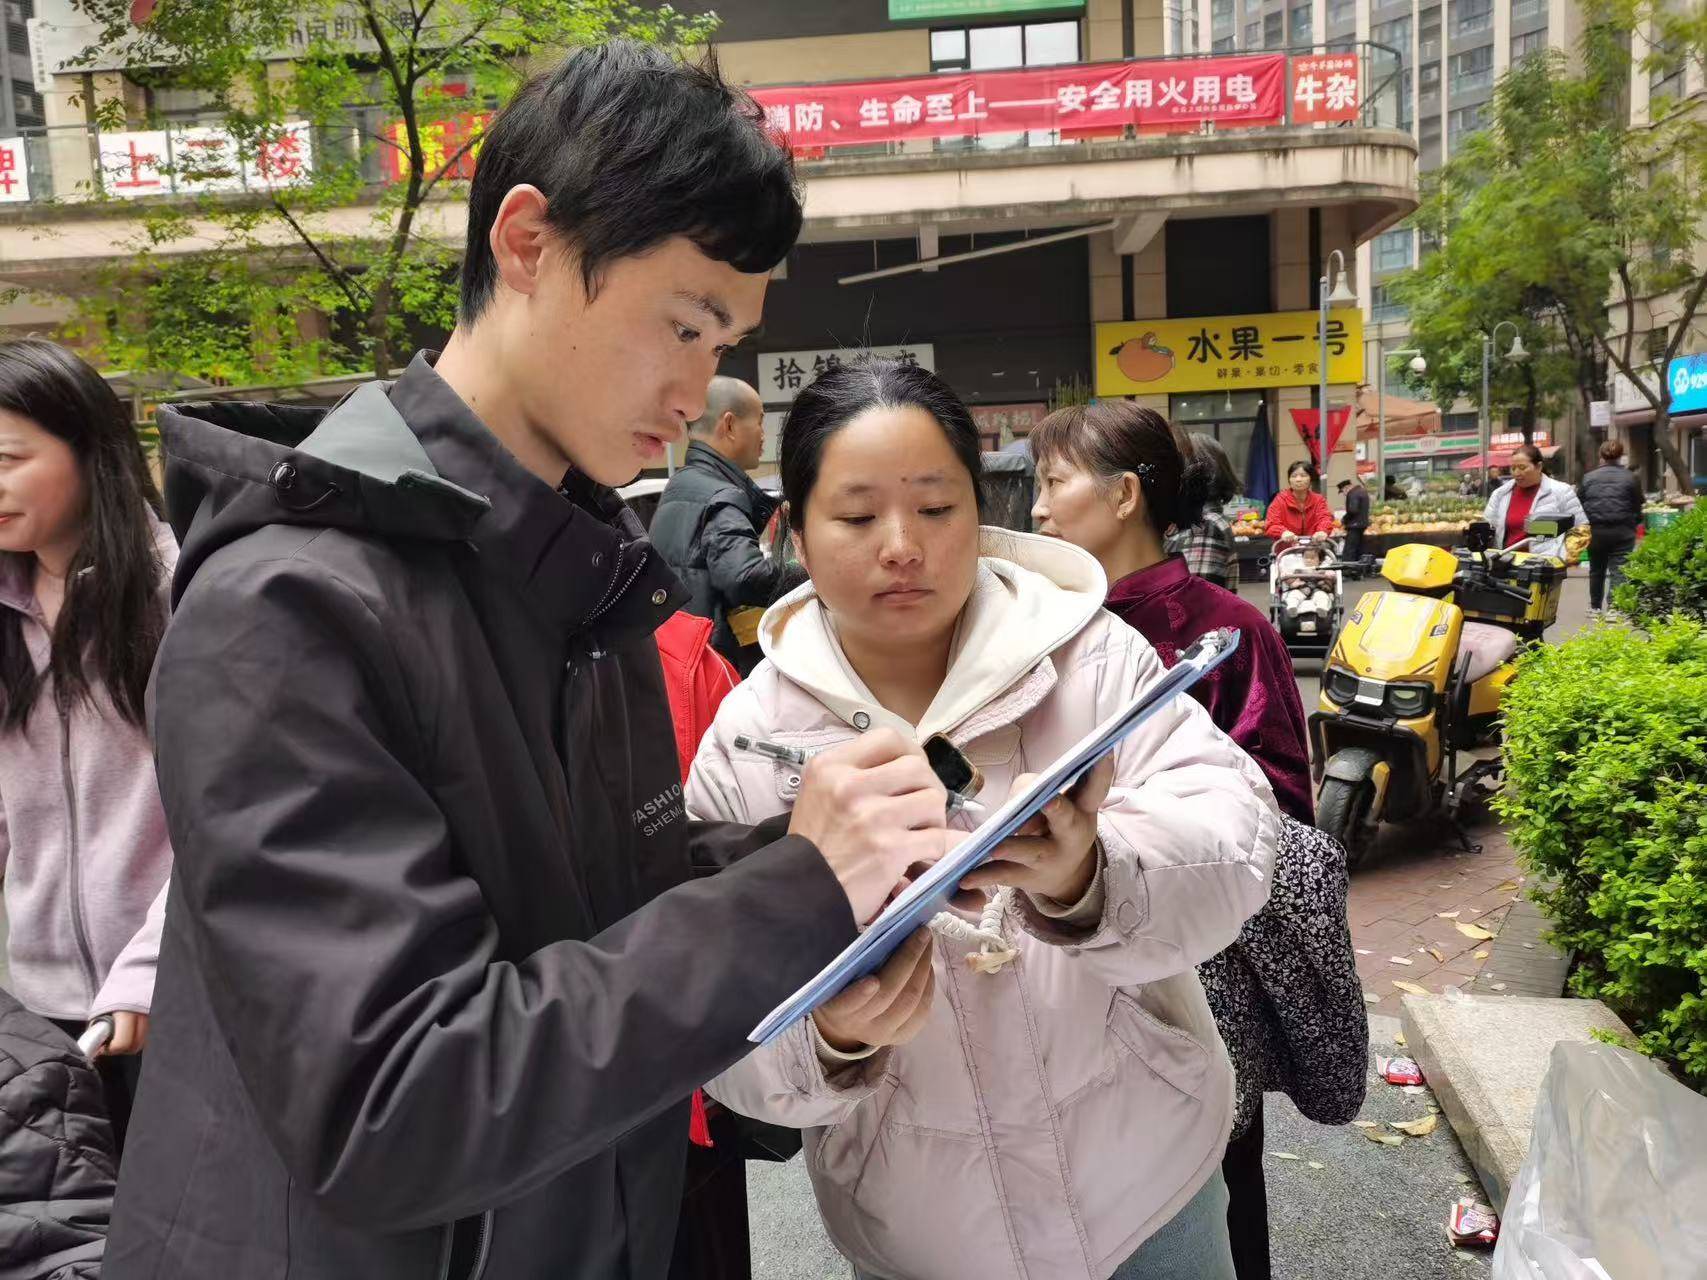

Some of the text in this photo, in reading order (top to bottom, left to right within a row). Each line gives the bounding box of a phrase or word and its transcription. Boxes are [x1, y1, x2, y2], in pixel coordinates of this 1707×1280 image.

[1294, 73, 1357, 112] 牛杂
[1187, 320, 1349, 363] 水果一号
